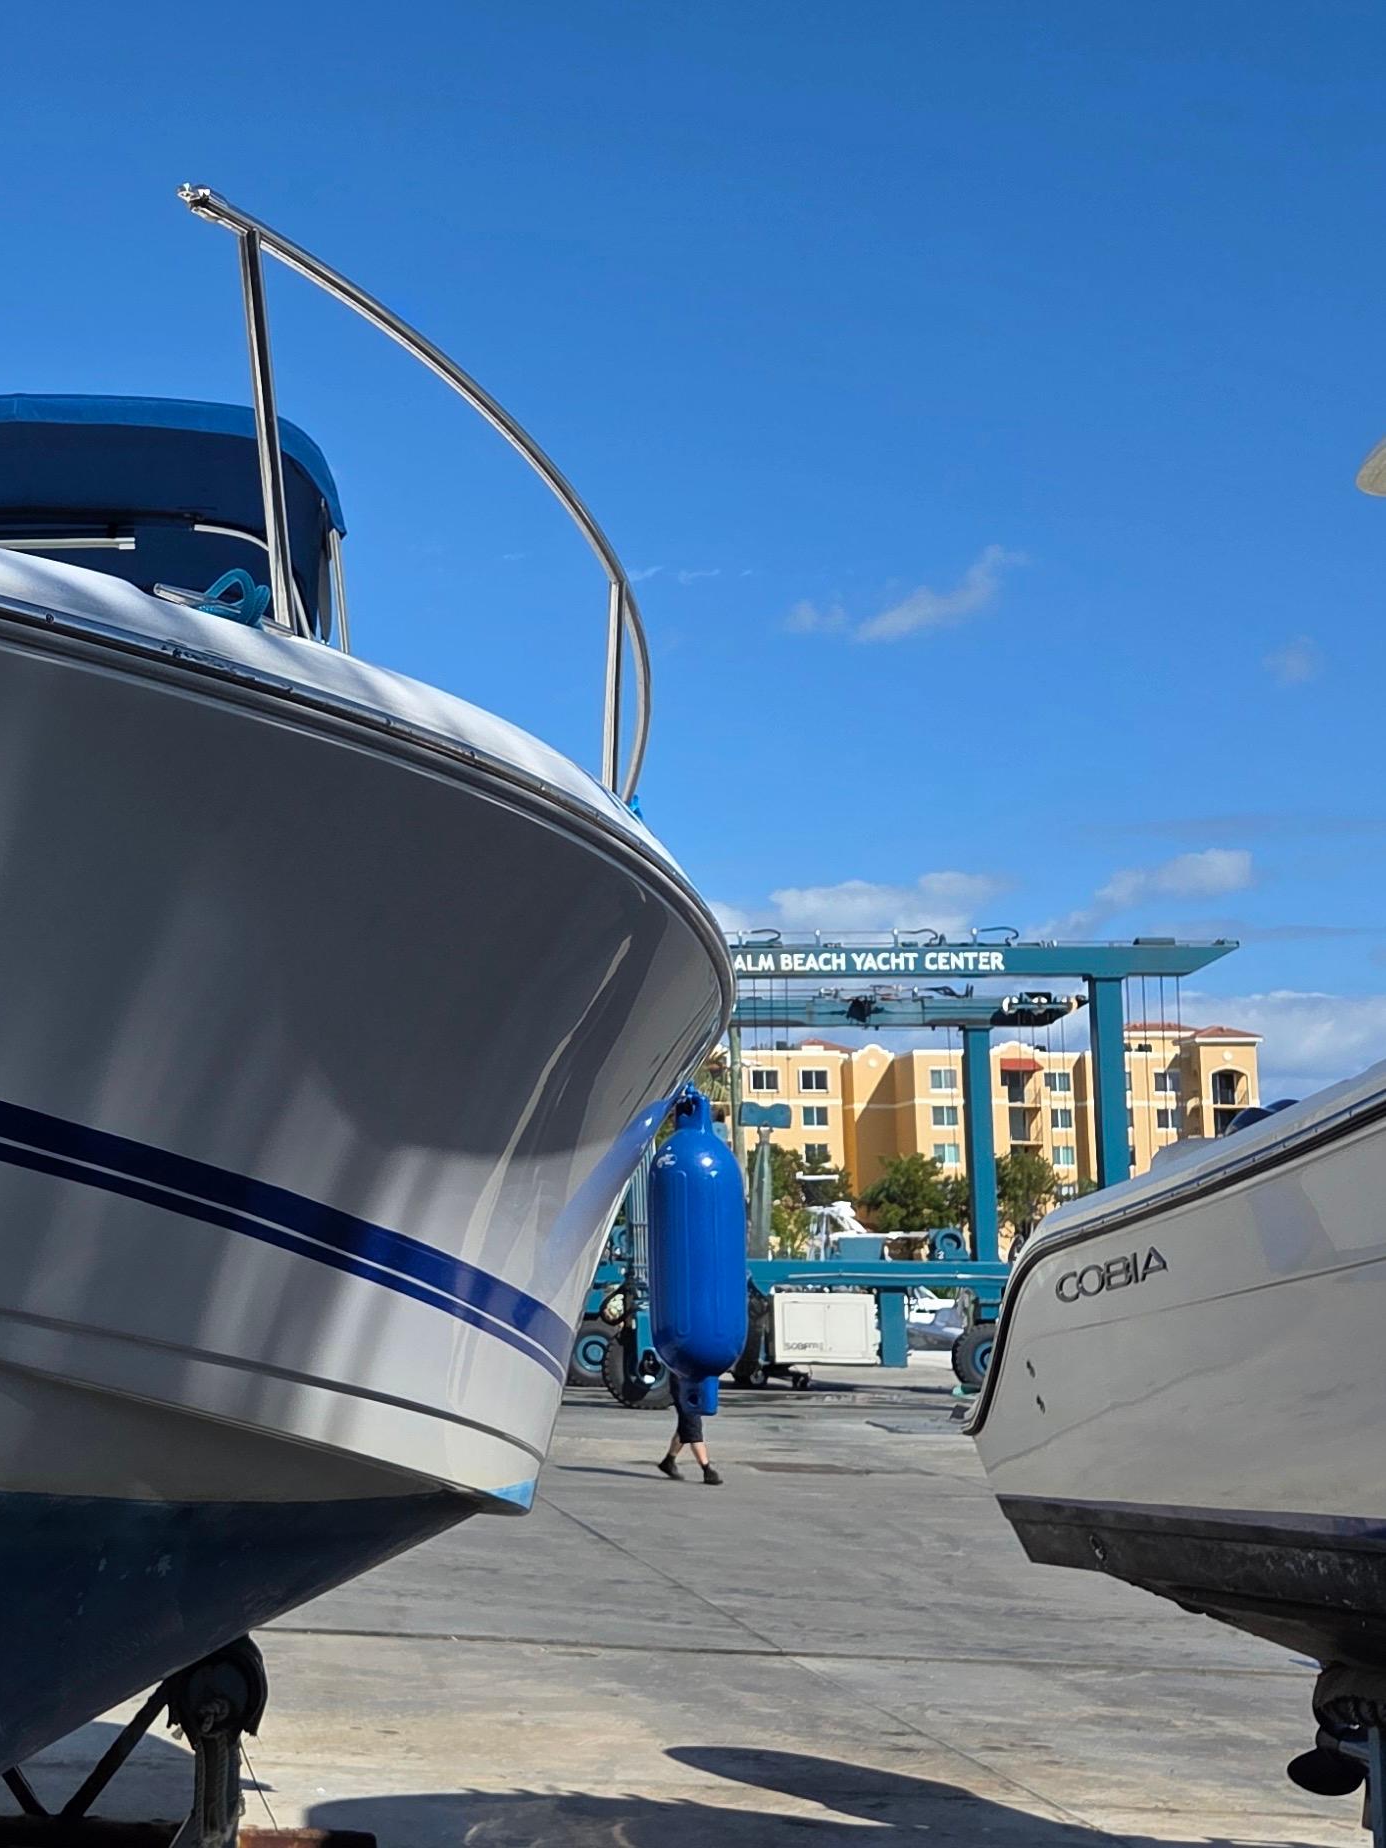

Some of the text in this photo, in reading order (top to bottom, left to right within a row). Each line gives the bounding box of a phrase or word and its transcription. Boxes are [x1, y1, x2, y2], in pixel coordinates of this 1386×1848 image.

[734, 952, 1005, 971] ALM BEACH YACHT CENTER
[1055, 1246, 1168, 1303] COBIA
